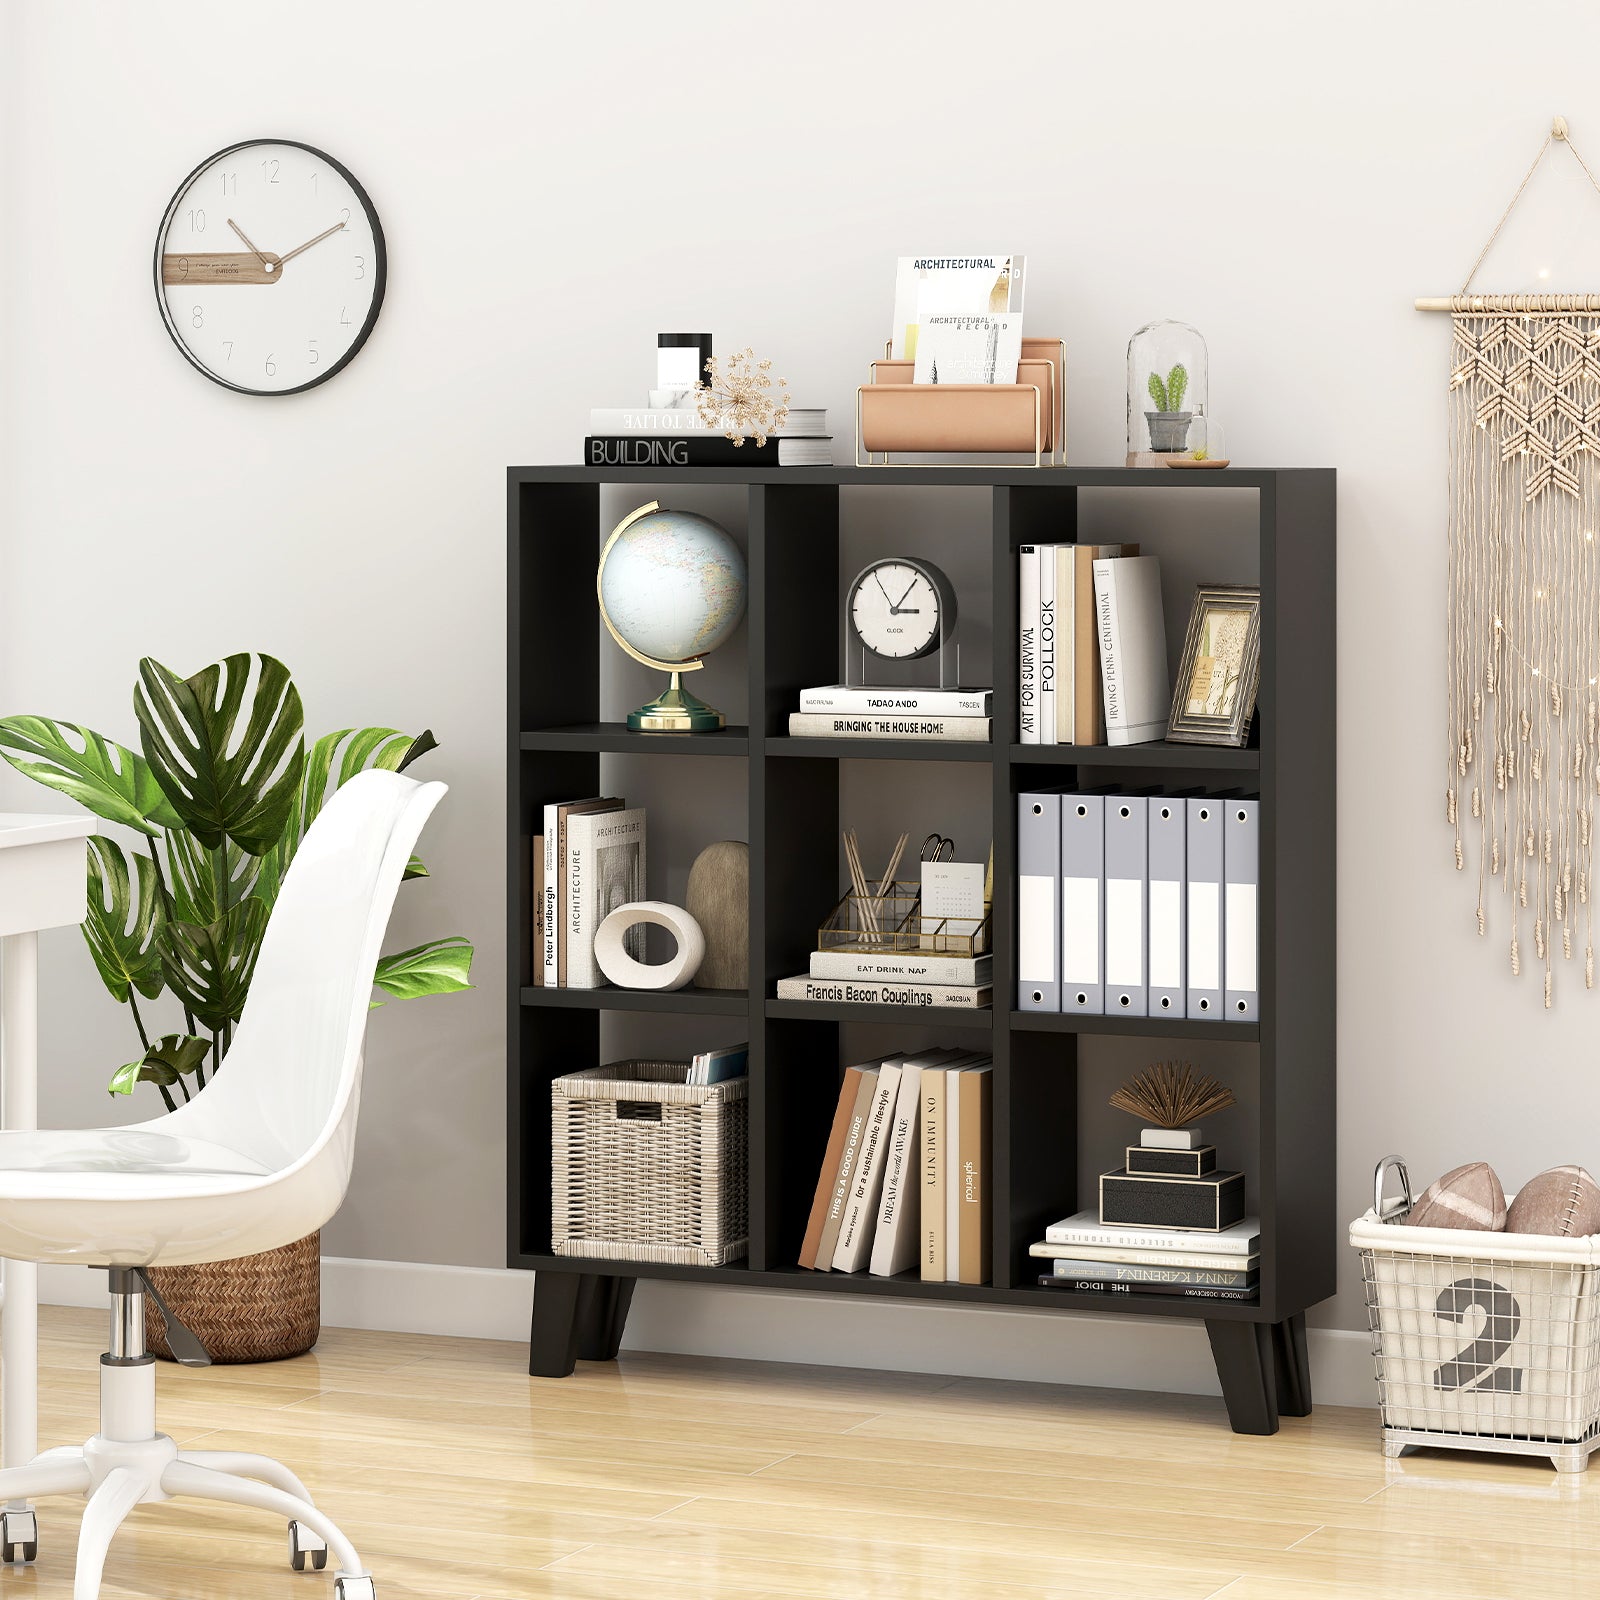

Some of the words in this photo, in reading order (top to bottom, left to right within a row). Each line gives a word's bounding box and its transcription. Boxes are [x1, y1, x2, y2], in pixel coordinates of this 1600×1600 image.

[261, 159, 280, 183] 12
[220, 173, 237, 197] 11
[310, 173, 318, 197] 1
[187, 209, 206, 233] 10
[340, 208, 351, 232] 2
[178, 257, 189, 281] 9
[354, 256, 365, 280] 3
[913, 259, 996, 270] ARCHITECTURAL
[192, 305, 204, 329] 8
[340, 306, 352, 329] 4
[956, 323, 1008, 331] RECORD
[222, 341, 234, 361] 7
[309, 340, 319, 364] 5
[265, 353, 277, 377] 6
[623, 414, 657, 429] LIVE
[662, 414, 683, 429] TO
[591, 440, 689, 465] BUILDING
[1100, 591, 1113, 651] CENTENNIAL
[1022, 627, 1034, 681] SURVIVAL
[1041, 600, 1054, 692] POLLOCK
[1105, 651, 1115, 684] PENN:
[867, 699, 894, 708] TADAO
[895, 699, 918, 708] ANDO
[1021, 683, 1034, 707] FOR
[1107, 684, 1118, 720] IRVING
[833, 720, 872, 732] BRINGING
[874, 721, 890, 733] THE
[892, 722, 919, 733] HOUSE
[920, 723, 944, 734] HOME
[1022, 711, 1034, 733] ART
[596, 822, 640, 838] ARCHITECTURE
[572, 850, 581, 934] ARCHITECTURE
[545, 886, 556, 937] Lindbergh
[545, 938, 554, 966] Peter
[857, 965, 873, 973] EAT
[876, 966, 904, 974] DRINK
[908, 967, 927, 975] NAP
[806, 984, 843, 1000] Francis
[846, 986, 878, 1002] Bacon
[881, 987, 933, 1007] Couplings
[927, 1097, 936, 1113] ON
[849, 1115, 863, 1146] GUIDE
[895, 1118, 909, 1154] AWAKE
[855, 1185, 865, 1199] for
[863, 1125, 880, 1177] sustainable
[873, 1089, 890, 1125] lifestyle
[927, 1120, 936, 1188] IMMUNITY
[841, 1147, 854, 1177] GOOD
[894, 1153, 902, 1174] world
[837, 1186, 845, 1197] IS
[839, 1179, 847, 1187] A
[891, 1174, 899, 1186] the
[963, 1161, 978, 1203] spherical
[830, 1198, 842, 1220] THIS
[883, 1187, 897, 1225] DREAM
[1064, 1233, 1111, 1243] STORIES
[1075, 1281, 1104, 1290] IDIOT
[1111, 1283, 1130, 1292] THE
[1116, 1268, 1191, 1283] KARENINA
[1194, 1272, 1238, 1285] ANNA
[1433, 1278, 1523, 1395] 2
